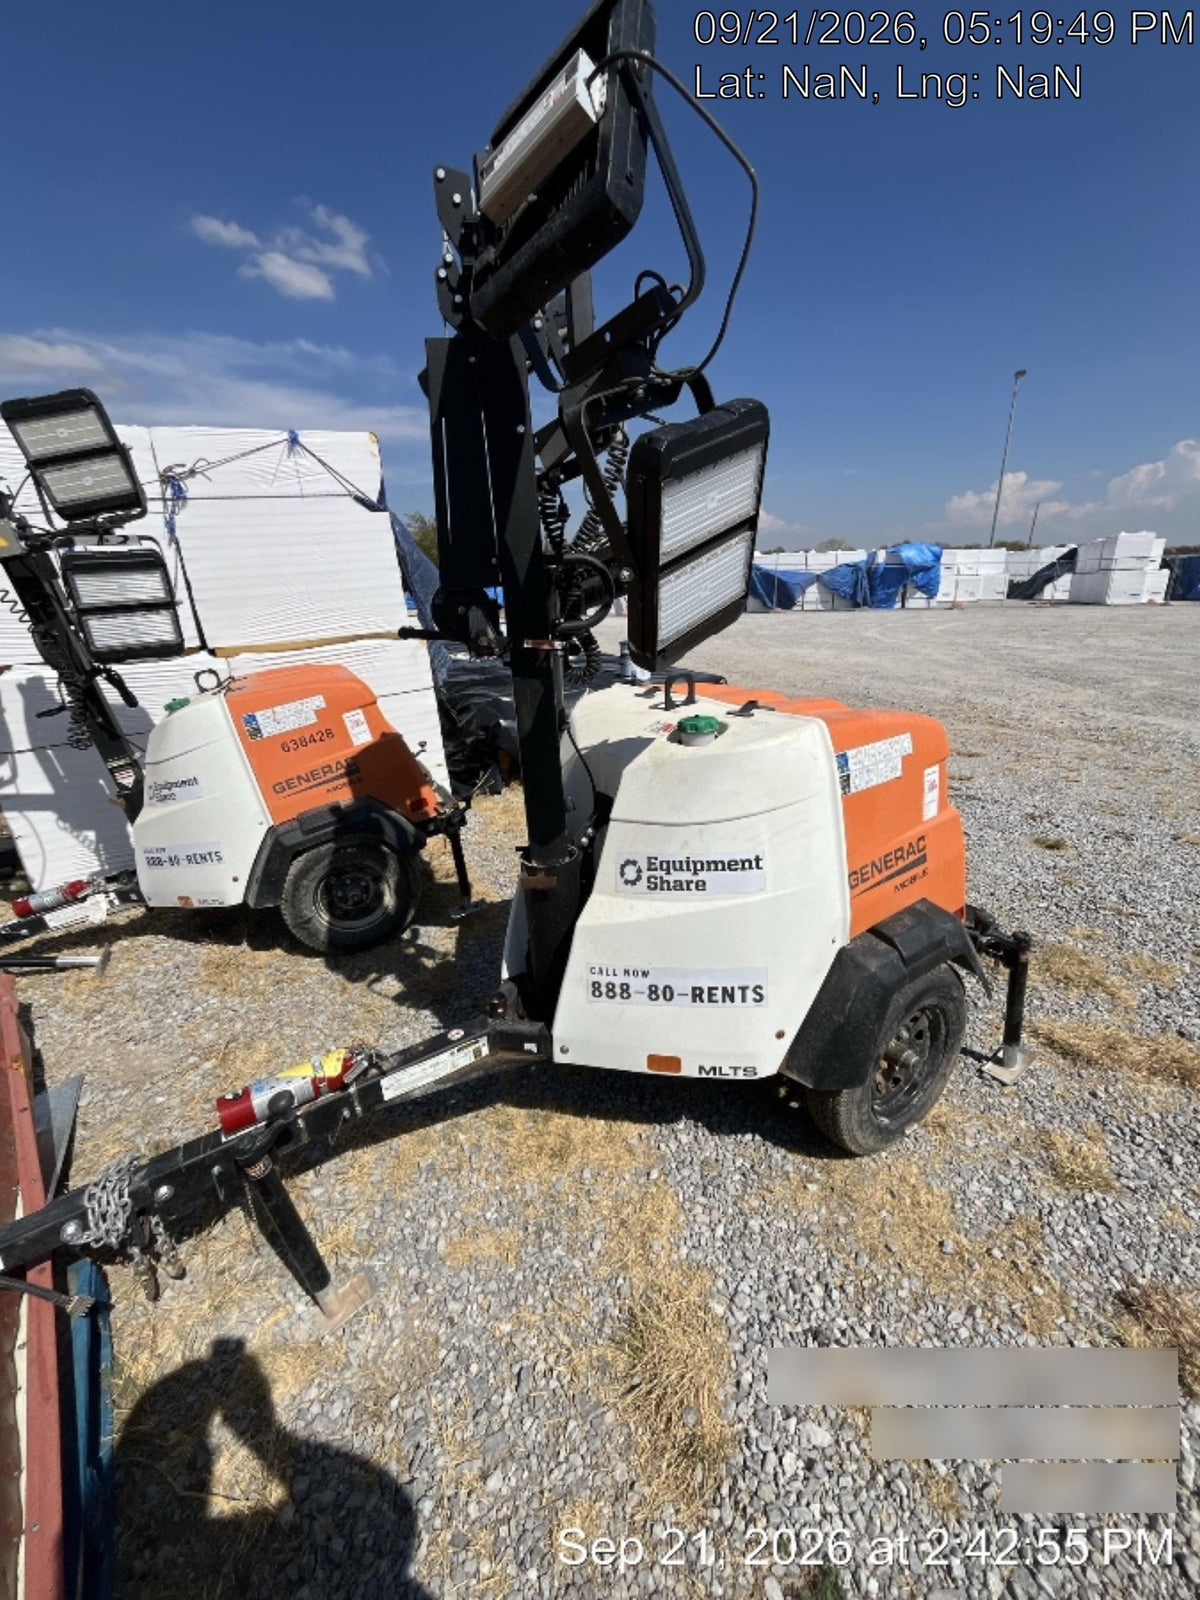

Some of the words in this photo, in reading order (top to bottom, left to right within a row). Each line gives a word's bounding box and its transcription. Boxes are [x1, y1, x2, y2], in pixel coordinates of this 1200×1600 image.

[646, 855, 764, 875] Equipment
[848, 835, 927, 889] GENERAC
[646, 875, 707, 892] Share
[590, 966, 618, 977] CALL
[623, 967, 650, 979] NOW
[591, 981, 765, 1004] 888-80-RENTS
[698, 1065, 758, 1077] MLTS
